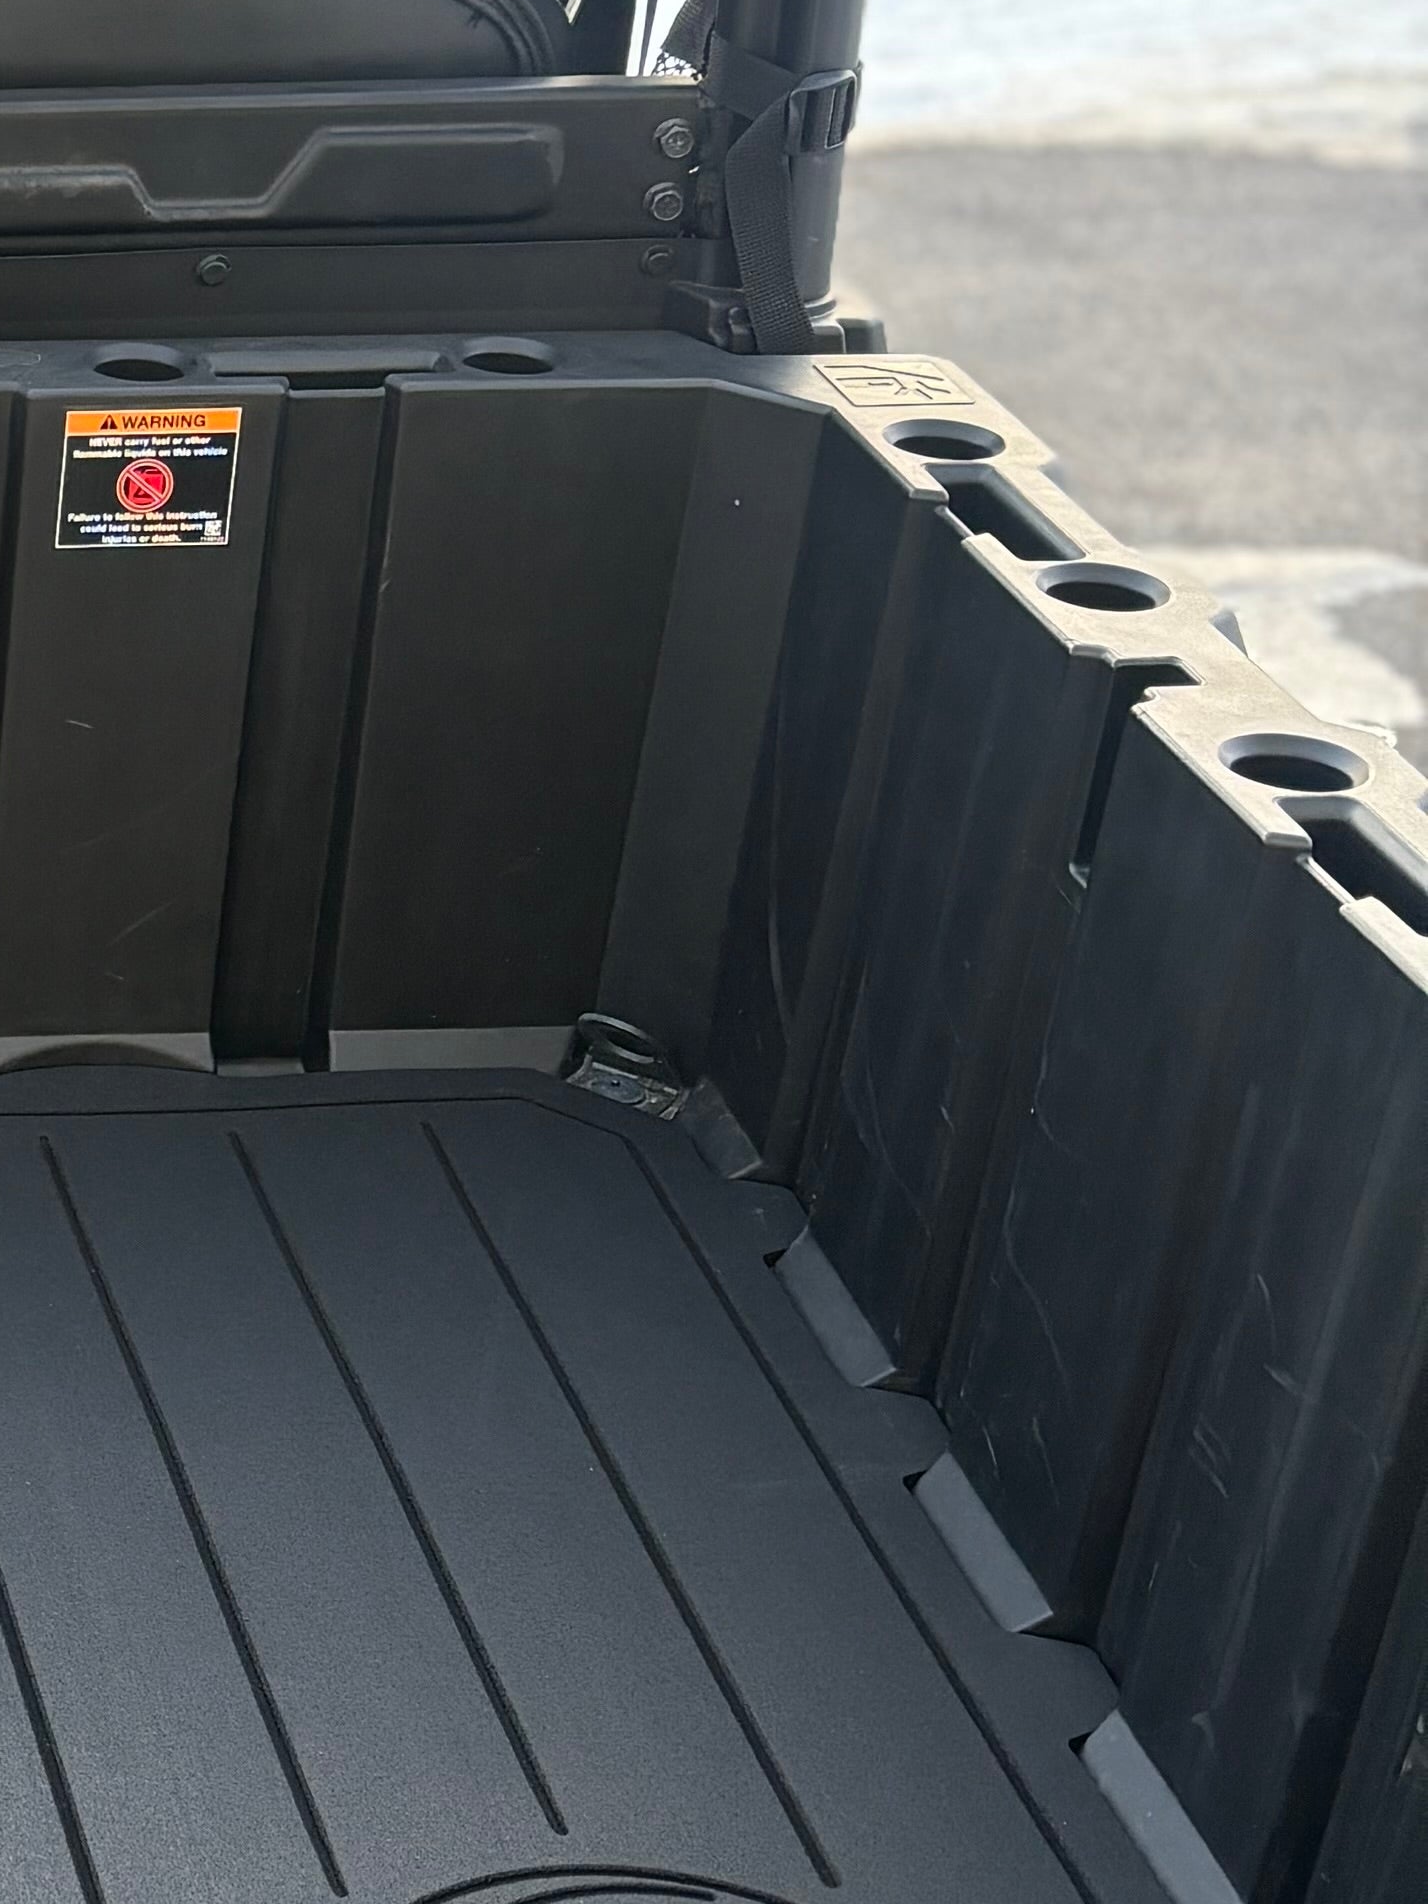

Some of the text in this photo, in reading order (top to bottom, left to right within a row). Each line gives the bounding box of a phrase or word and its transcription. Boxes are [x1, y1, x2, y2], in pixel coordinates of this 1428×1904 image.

[123, 415, 206, 429] WARNING
[124, 438, 149, 447] carry
[185, 436, 211, 444] other
[173, 448, 191, 456] this
[194, 447, 228, 456] vehicle
[68, 513, 100, 522] Failure
[146, 512, 163, 520] this
[166, 511, 217, 520] instruction
[80, 524, 106, 533] could
[109, 524, 129, 532] lead
[132, 524, 141, 532] to
[144, 523, 178, 531] serious
